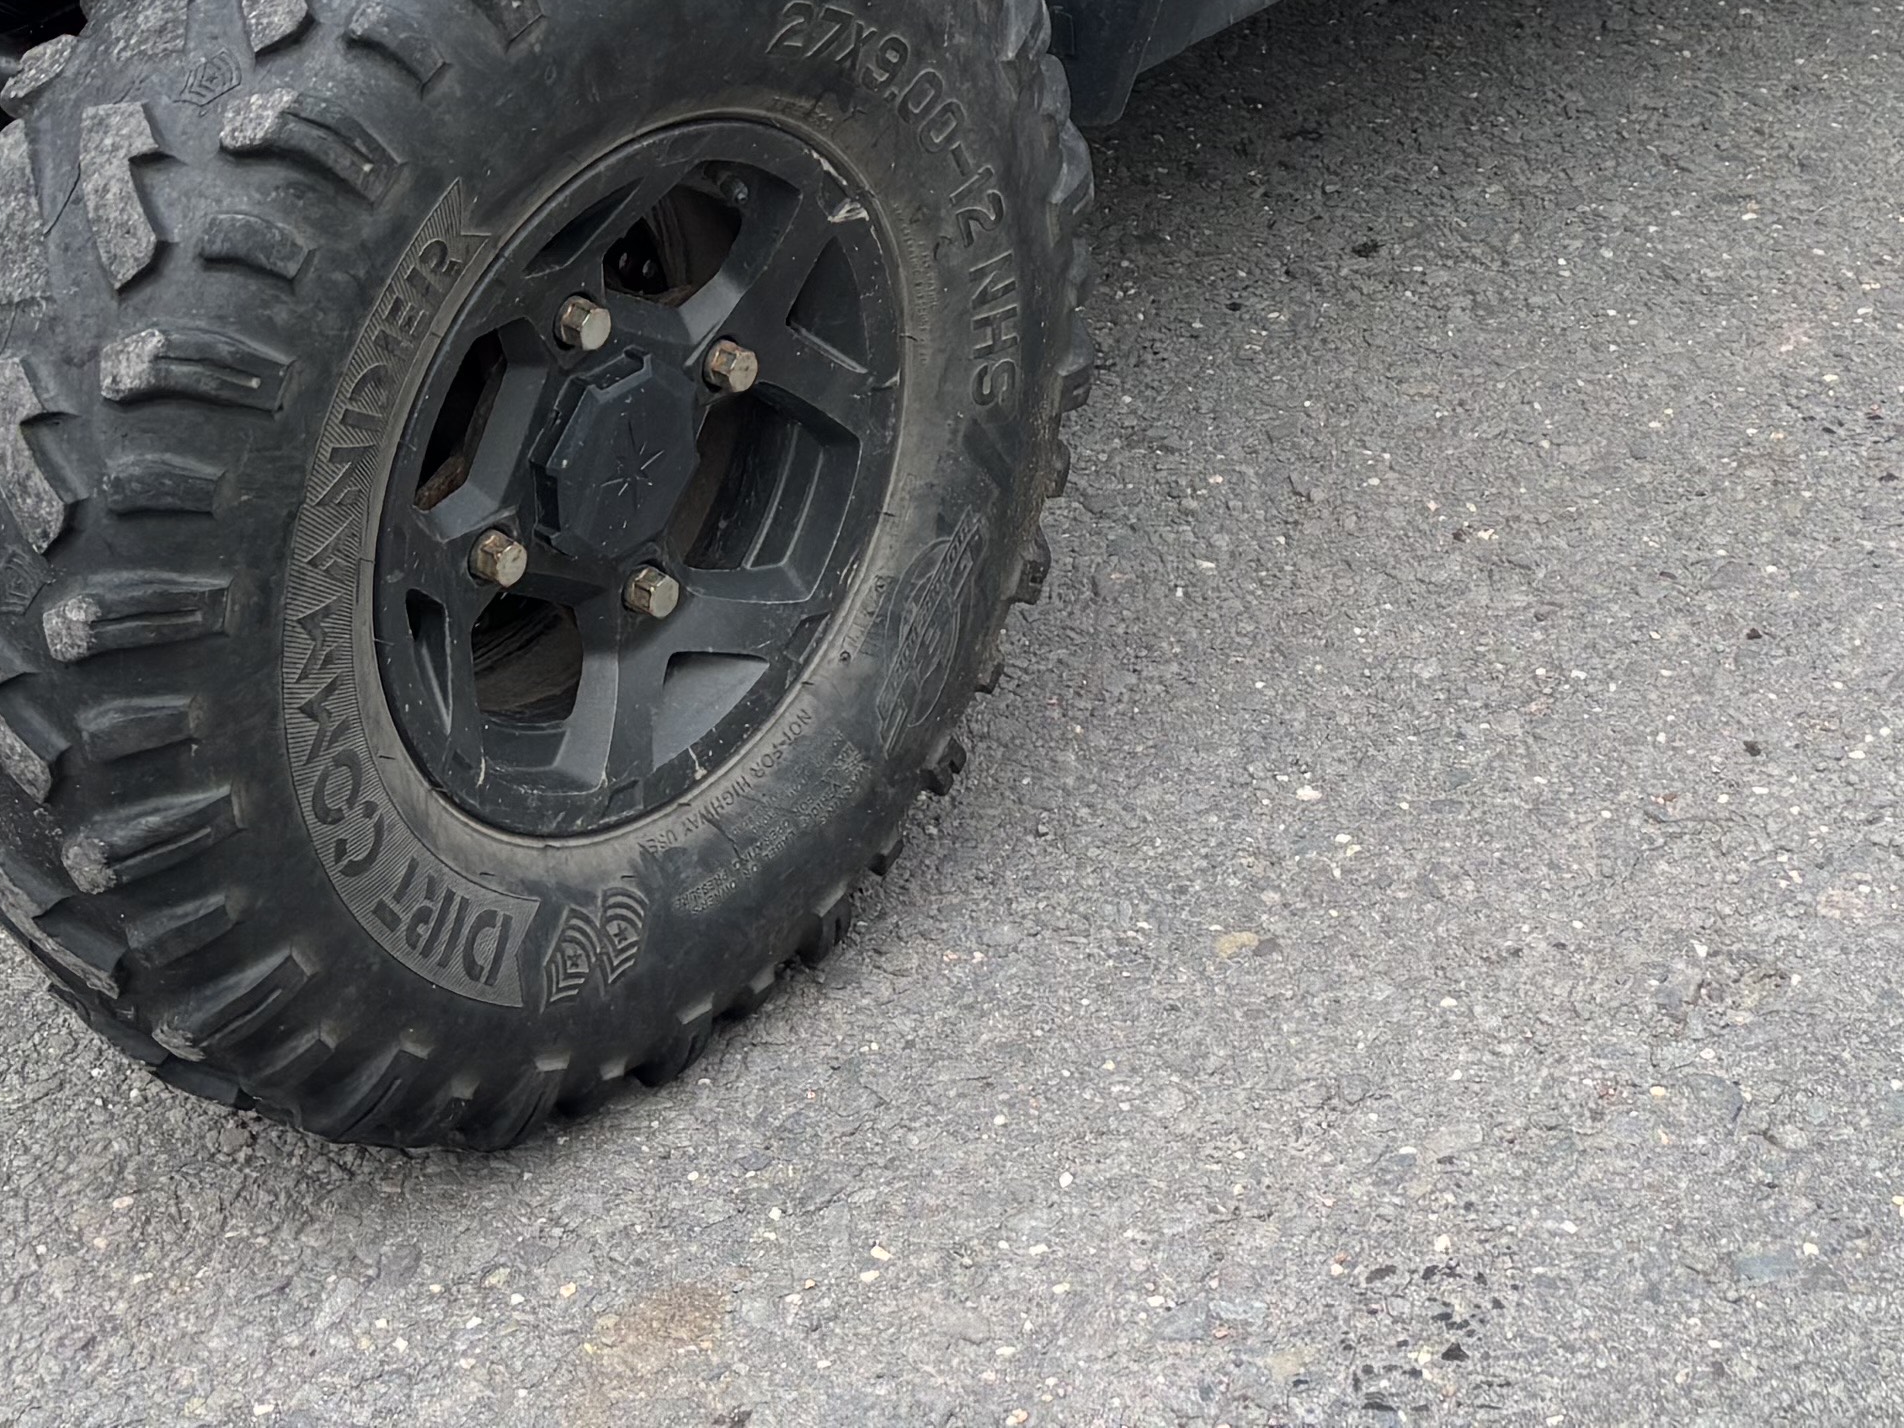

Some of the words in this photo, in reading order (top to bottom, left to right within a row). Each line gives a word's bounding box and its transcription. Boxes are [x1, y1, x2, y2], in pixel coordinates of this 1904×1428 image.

[968, 250, 1020, 409] NHS
[293, 238, 465, 878] COMMANDER
[682, 774, 752, 837] HIGHWAY
[372, 855, 514, 988] DIRT
